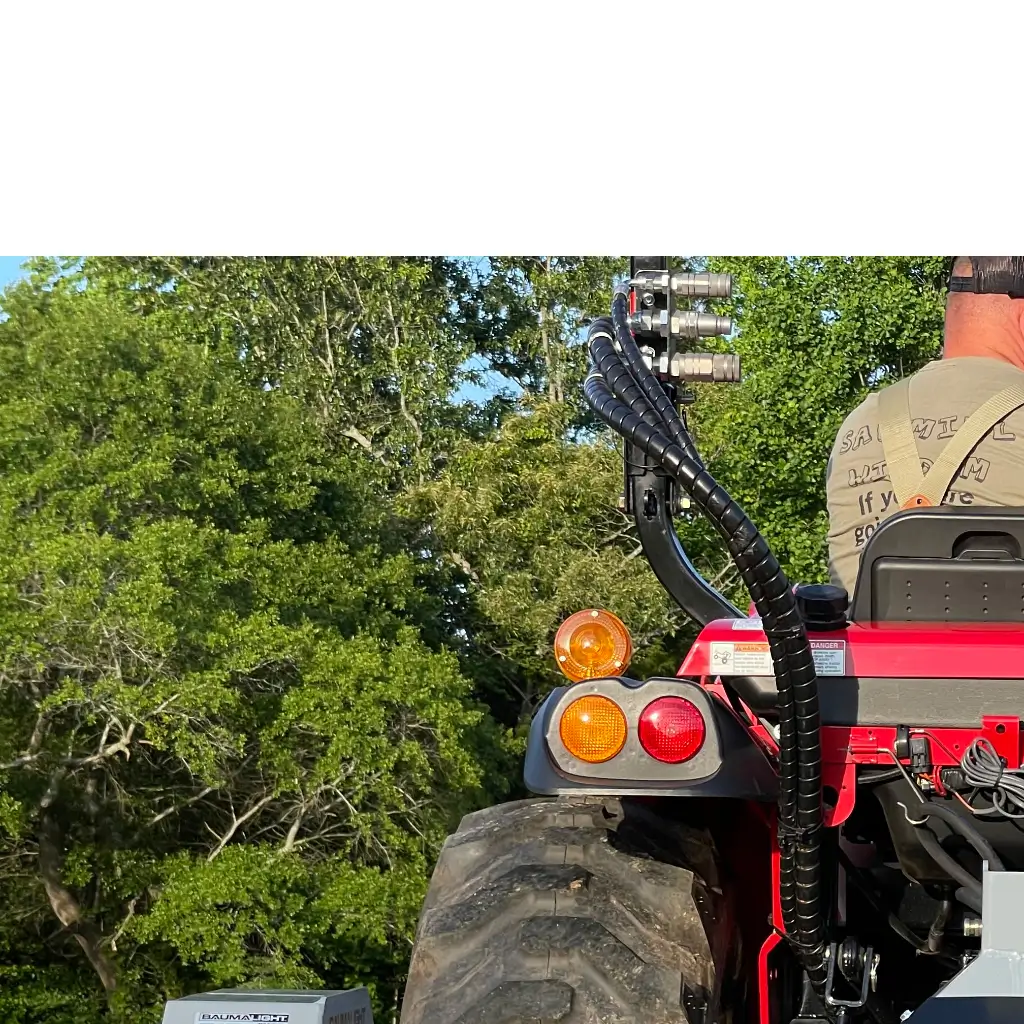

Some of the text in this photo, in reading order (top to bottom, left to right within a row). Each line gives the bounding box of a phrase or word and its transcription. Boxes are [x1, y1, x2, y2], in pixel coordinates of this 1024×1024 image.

[840, 416, 1016, 454] SAMIL
[858, 490, 873, 516] If
[202, 1013, 288, 1023] BAUMALIGHT
